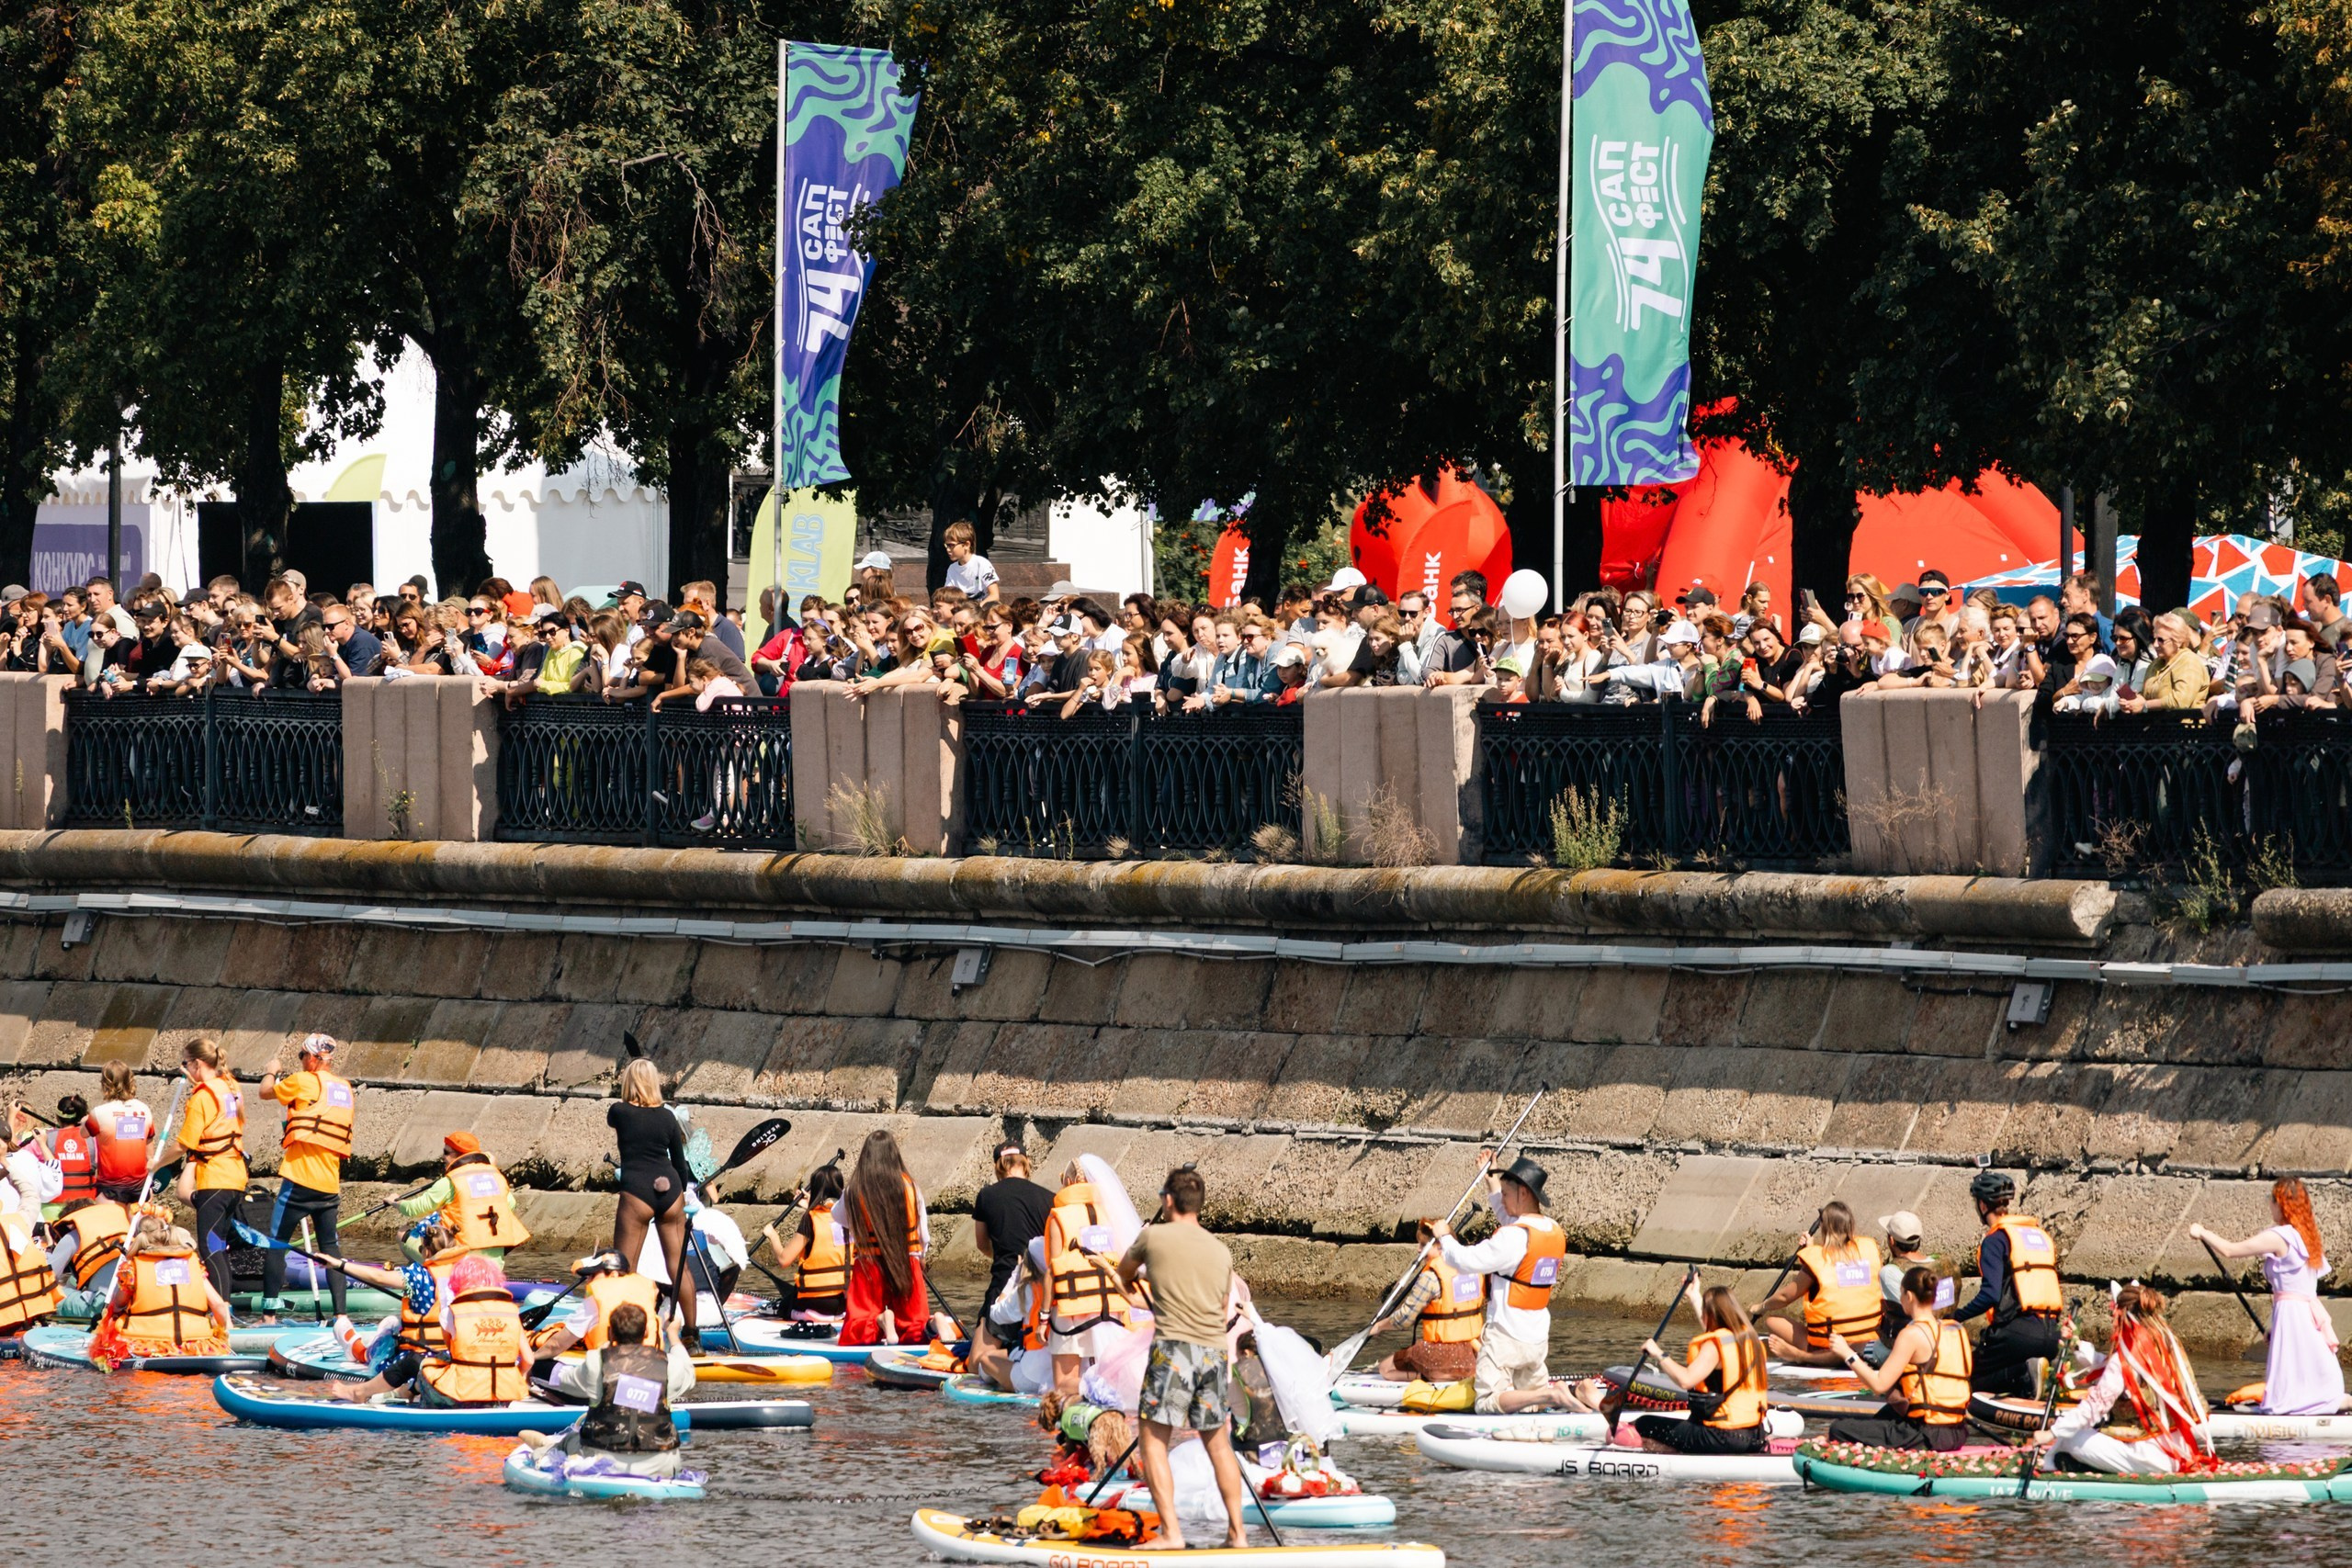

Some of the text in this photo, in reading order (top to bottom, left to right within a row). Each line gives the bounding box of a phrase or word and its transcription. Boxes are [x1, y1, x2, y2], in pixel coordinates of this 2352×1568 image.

[1599, 141, 1633, 227] САП
[1629, 141, 1664, 229] ФЕСТ
[803, 184, 827, 261] САП
[1618, 237, 1683, 331] 74
[806, 268, 860, 353] 74
[752, 1123, 780, 1147] HEALING
[58, 1152, 85, 1160] YAMAHA
[627, 1387, 650, 1403] 0777
[1637, 1383, 1677, 1401] BODY GLOVE
[1995, 1410, 2021, 1426] RAVE
[1589, 1461, 1659, 1477] BOARD
